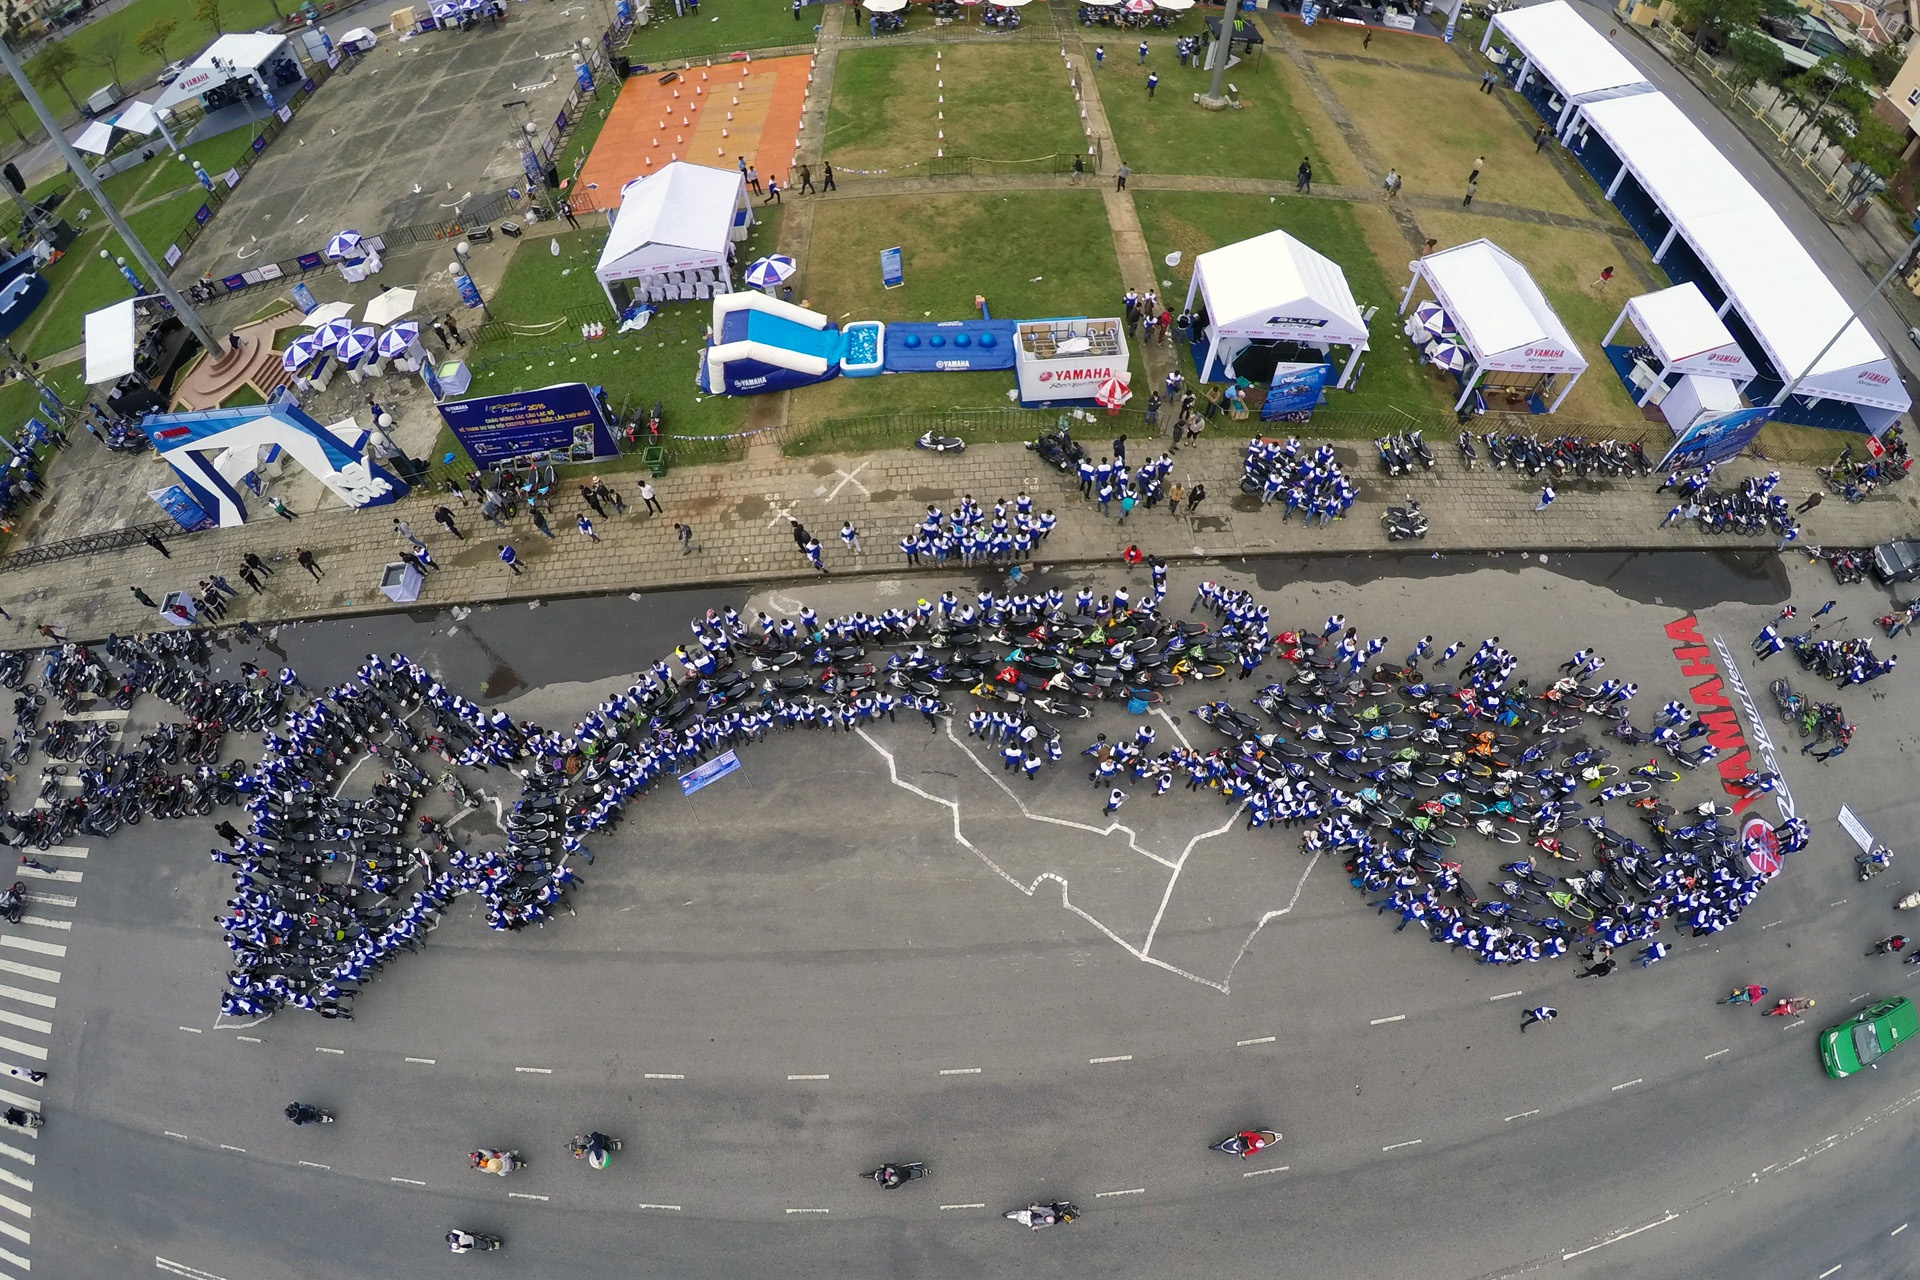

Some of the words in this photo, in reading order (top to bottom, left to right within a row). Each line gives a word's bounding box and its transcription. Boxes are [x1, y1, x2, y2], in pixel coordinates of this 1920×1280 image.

[185, 72, 210, 87] YAMAHA
[1277, 317, 1321, 325] BLUE
[1534, 348, 1564, 358] YAMAHA
[1715, 354, 1742, 364] YAMAHA
[1056, 368, 1111, 380] YAMAHA
[741, 376, 767, 386] YAMAHA
[527, 403, 546, 411] 2015
[1713, 636, 1749, 697] Heart
[1664, 616, 1764, 816] YAMAHA
